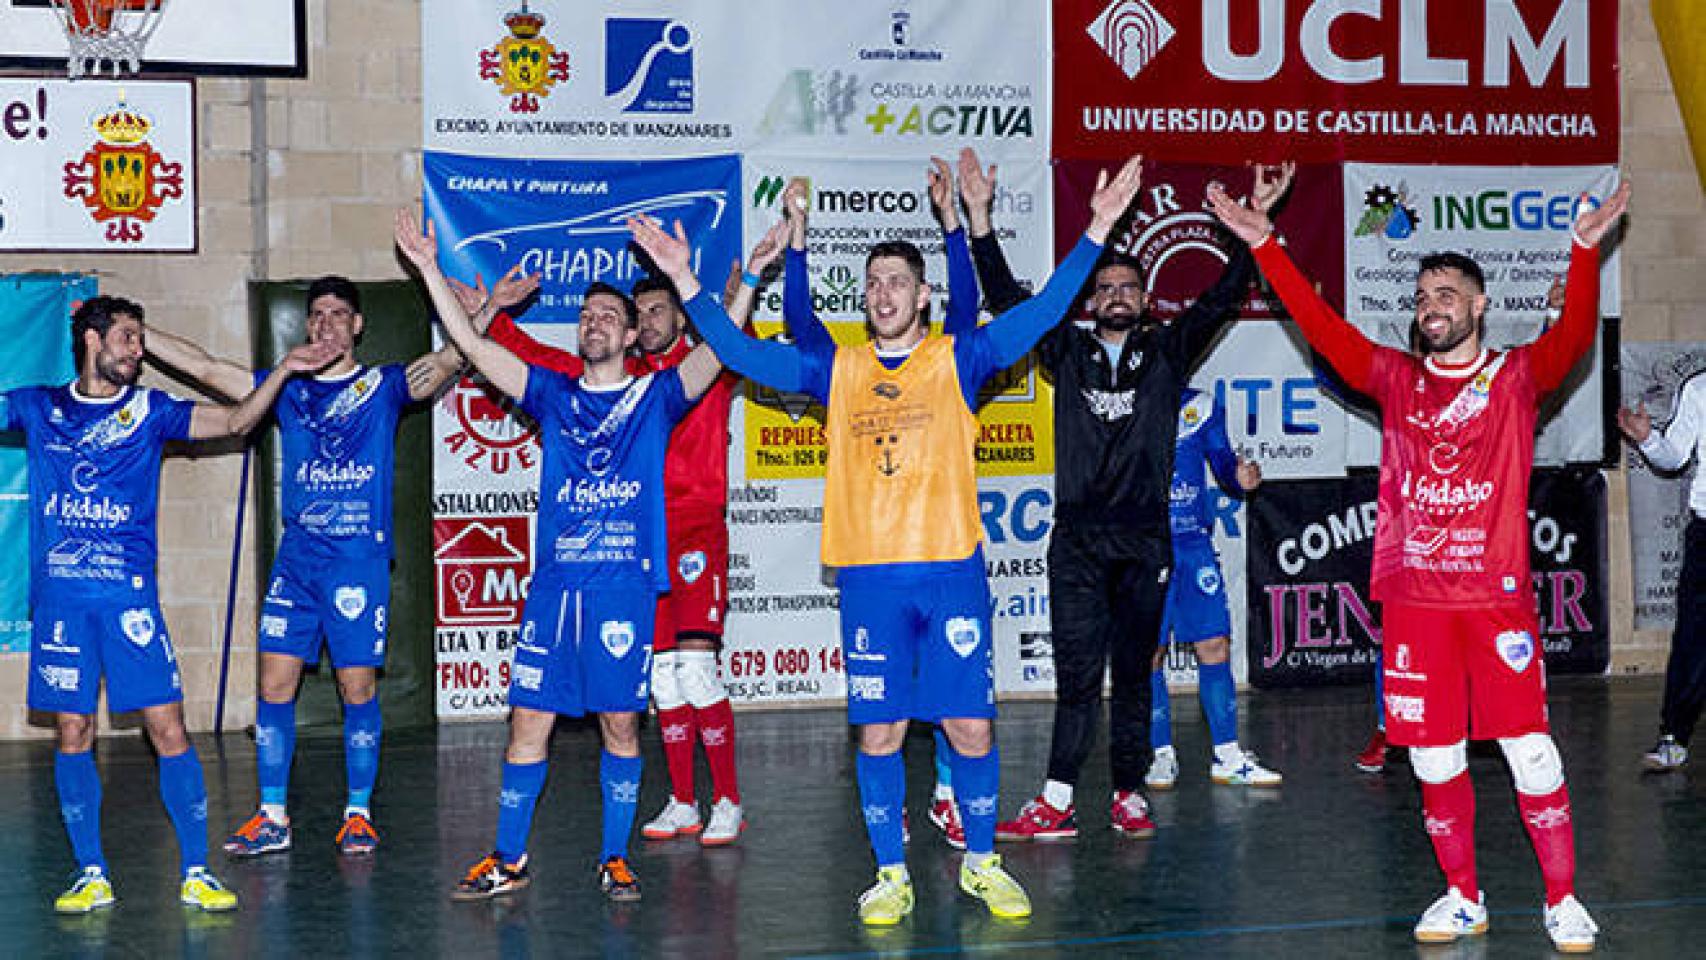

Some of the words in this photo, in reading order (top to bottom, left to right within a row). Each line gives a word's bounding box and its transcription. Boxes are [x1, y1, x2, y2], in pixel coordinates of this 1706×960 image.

[1202, 0, 1590, 88] UCLM
[496, 121, 608, 137] AYUNTAMIENTO
[609, 122, 629, 137] DE
[633, 123, 732, 138] MANZANARES
[1082, 106, 1266, 133] UNIVERSIDAD
[1274, 108, 1309, 132] DE
[1317, 109, 1476, 136] CASTILLA-LA
[1485, 112, 1597, 137] MANCHA
[447, 175, 508, 191] CHAPA
[511, 177, 524, 192] Y
[526, 180, 608, 195] PINTURA
[759, 426, 827, 446] REPUES
[978, 424, 1034, 443] ICLETA
[444, 431, 542, 474] AZUE
[1259, 442, 1314, 459] Futuro
[432, 491, 540, 514] STALACIONES
[438, 631, 469, 653] LTA
[477, 630, 489, 652] Y
[730, 651, 766, 676] 679
[774, 649, 809, 675] 080
[818, 646, 842, 674] 14
